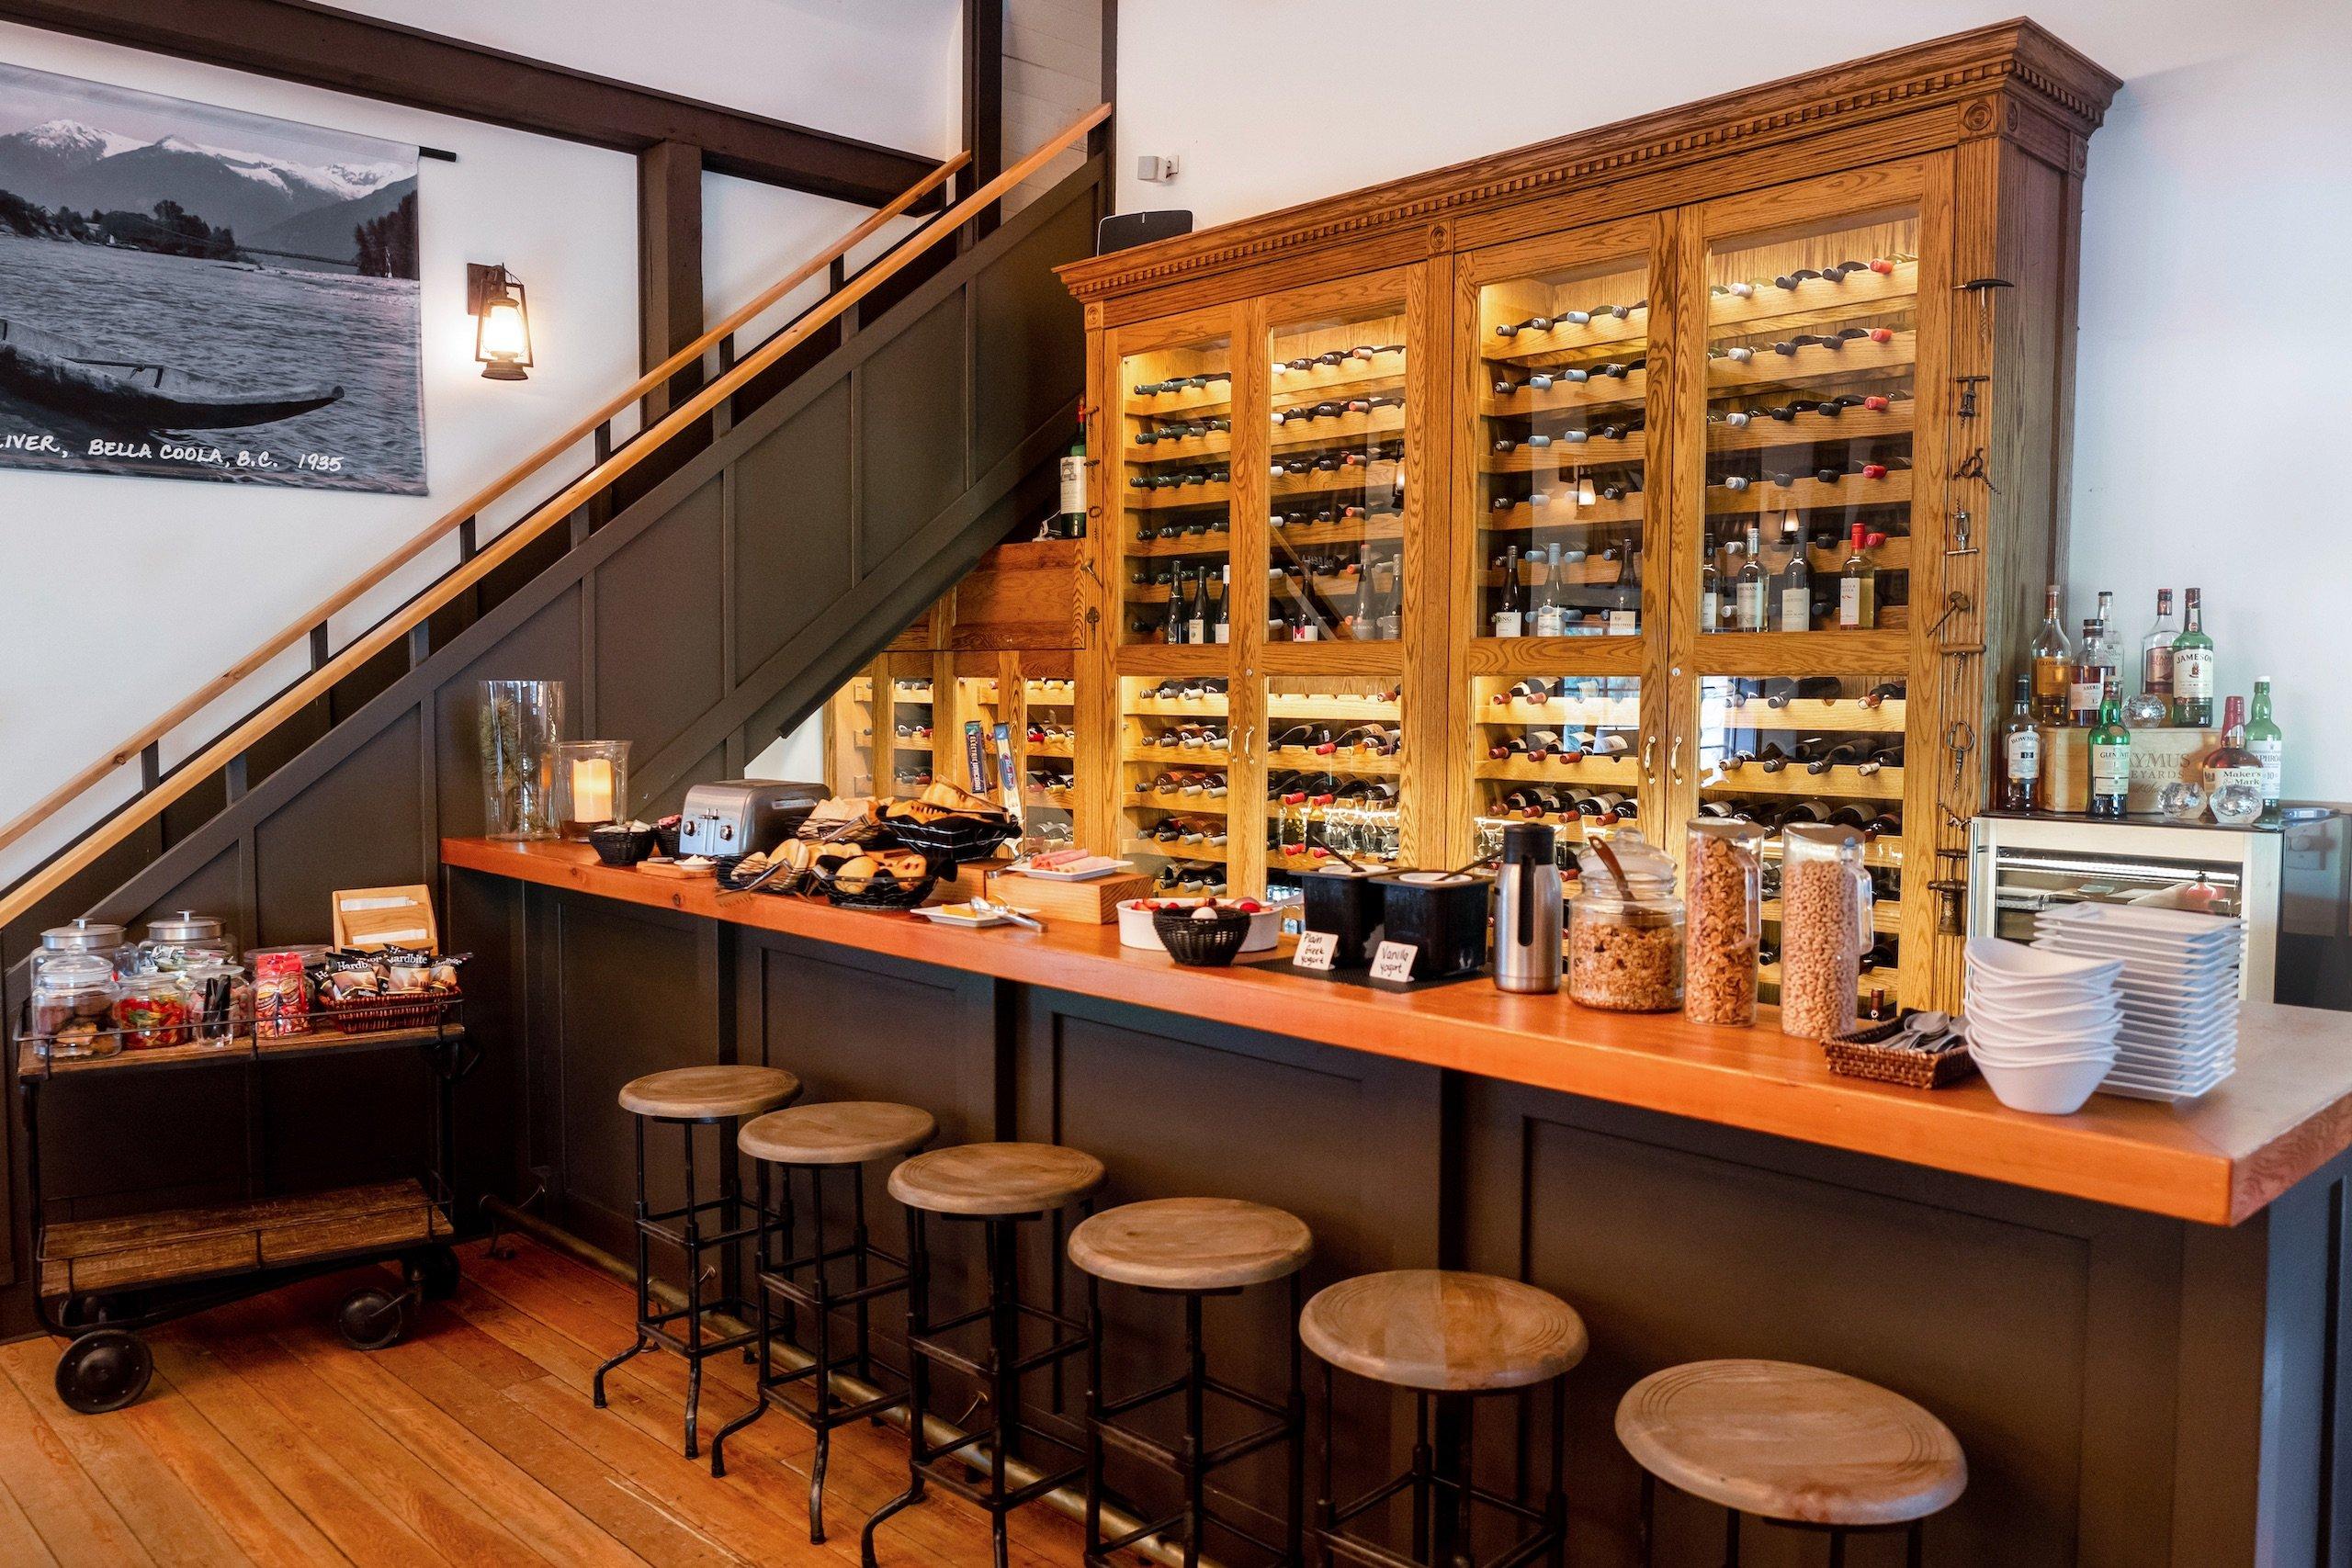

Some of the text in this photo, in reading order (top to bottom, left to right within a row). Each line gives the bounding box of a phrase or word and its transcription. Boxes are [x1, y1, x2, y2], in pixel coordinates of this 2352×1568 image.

[87, 438, 153, 459] BELLA
[159, 444, 231, 468] COOLA,
[236, 450, 278, 468] B.C.
[298, 453, 345, 472] 1935
[2129, 752, 2190, 768] YMUS
[2131, 771, 2185, 780] EYARDS
[1304, 932, 1323, 944] Plain
[387, 953, 428, 964] ardbite
[1382, 946, 1409, 962] Vanilla
[336, 960, 368, 972] Hardb
